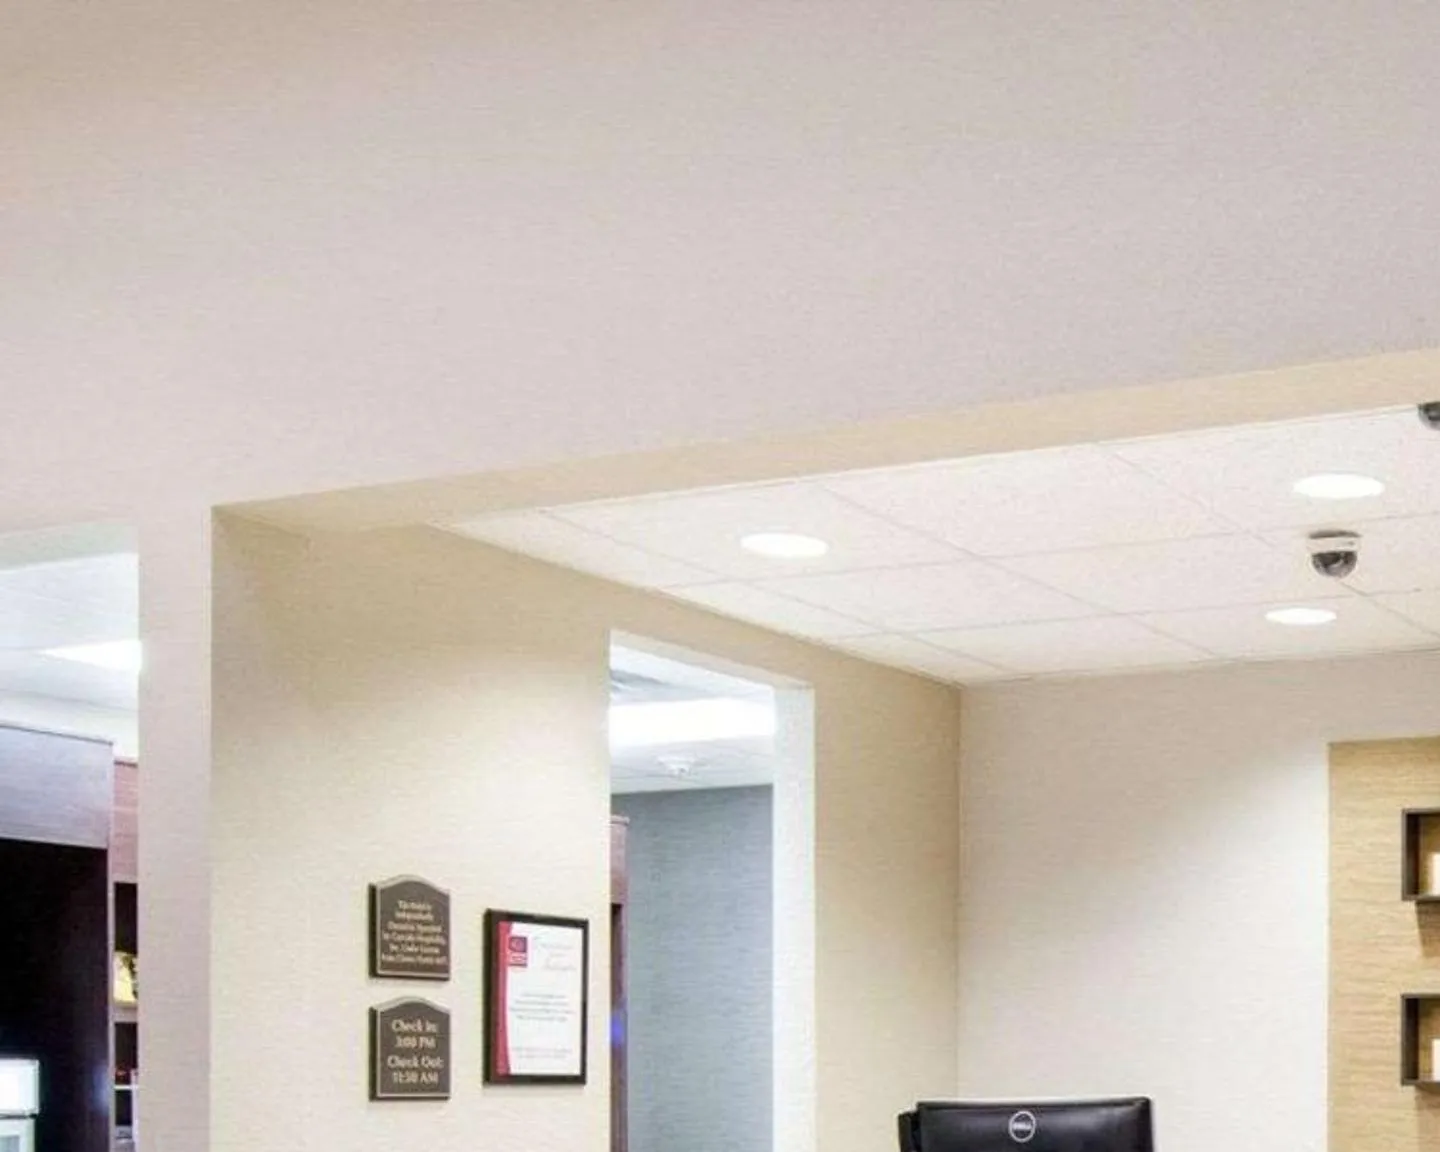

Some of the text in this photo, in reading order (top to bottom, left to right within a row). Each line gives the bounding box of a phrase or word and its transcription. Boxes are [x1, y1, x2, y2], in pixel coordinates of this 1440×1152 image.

[391, 1019, 422, 1032] Check
[419, 1036, 436, 1049] PM
[387, 1055, 418, 1068] Check
[420, 1071, 439, 1084] AM
